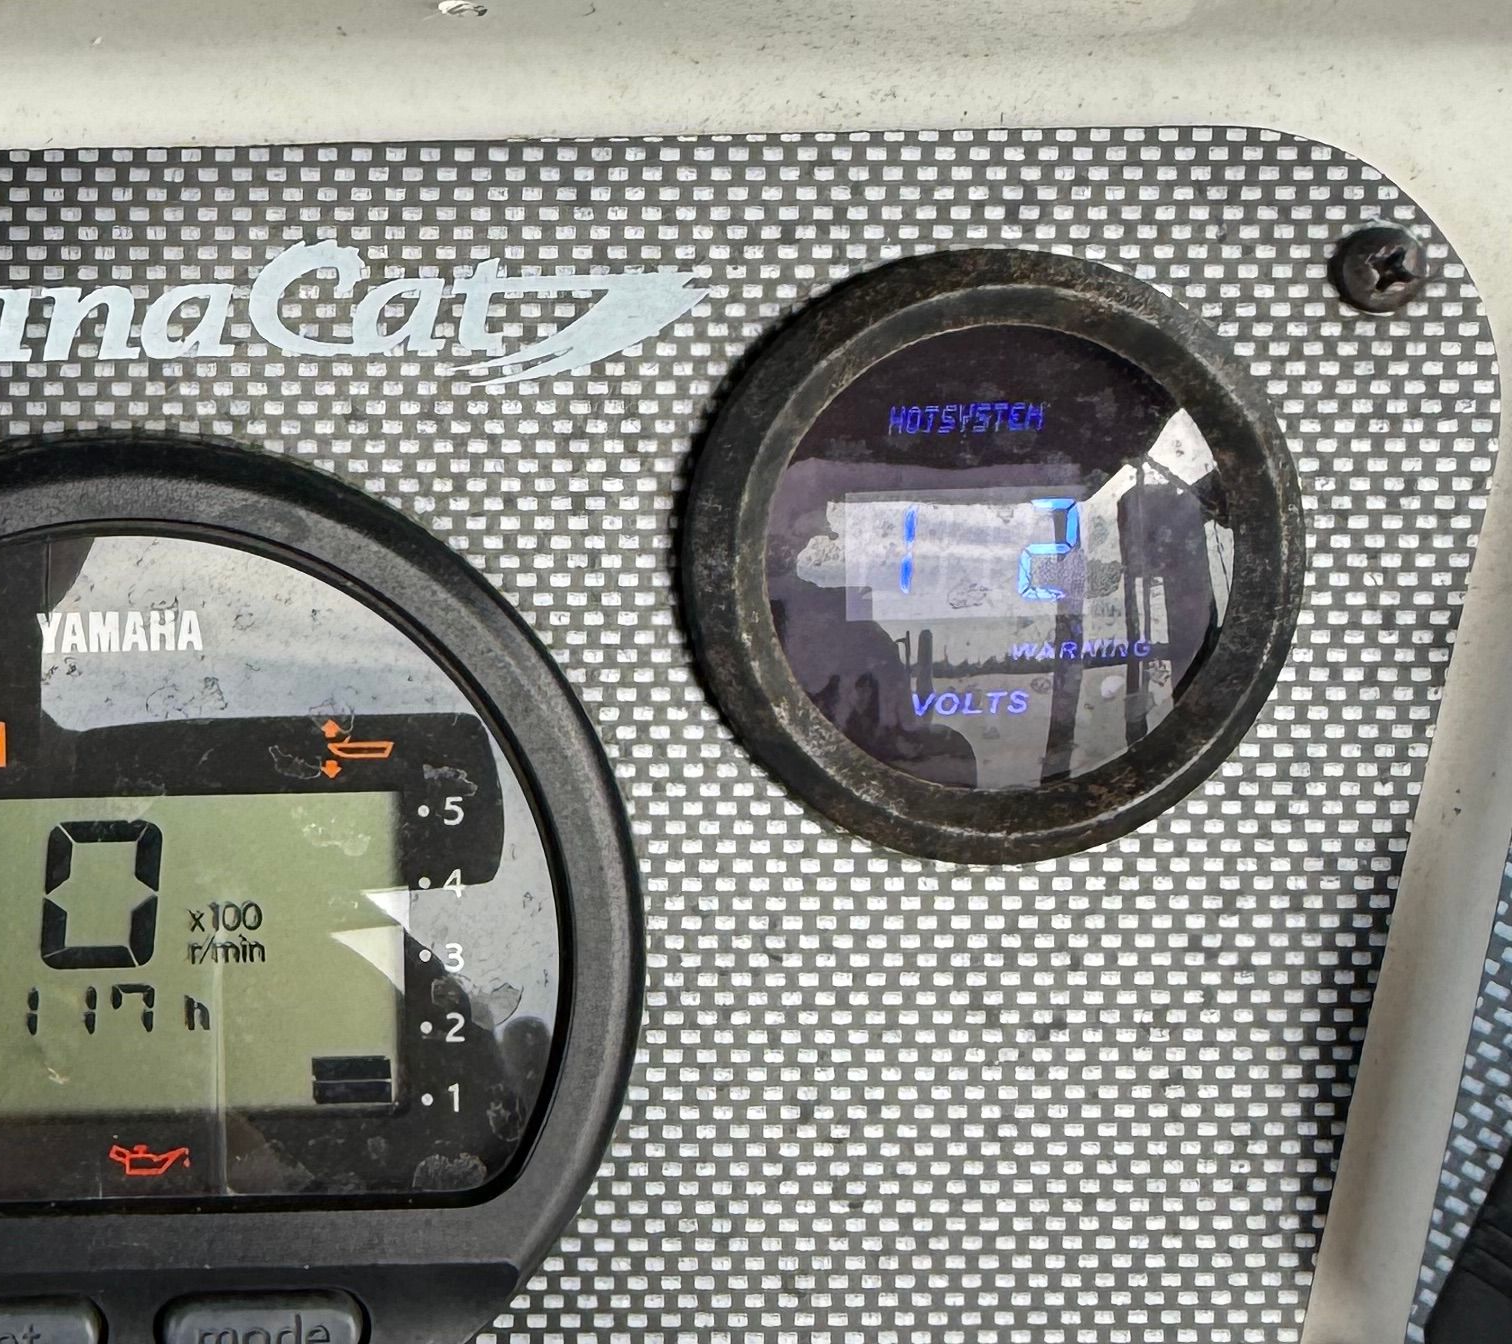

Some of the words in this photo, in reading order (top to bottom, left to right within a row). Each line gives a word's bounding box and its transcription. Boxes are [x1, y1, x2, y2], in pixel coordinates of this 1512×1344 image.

[37, 609, 204, 654] YAMAHA
[1011, 637, 1152, 662] WARNING
[912, 690, 1030, 717] VOLTS
[443, 796, 465, 826] 5
[40, 819, 164, 971] 0
[442, 868, 464, 898] 4
[188, 900, 263, 933] x100
[188, 934, 267, 966] r/min
[444, 942, 466, 973] 3
[445, 1012, 466, 1043] 2
[447, 1082, 461, 1112] 1
